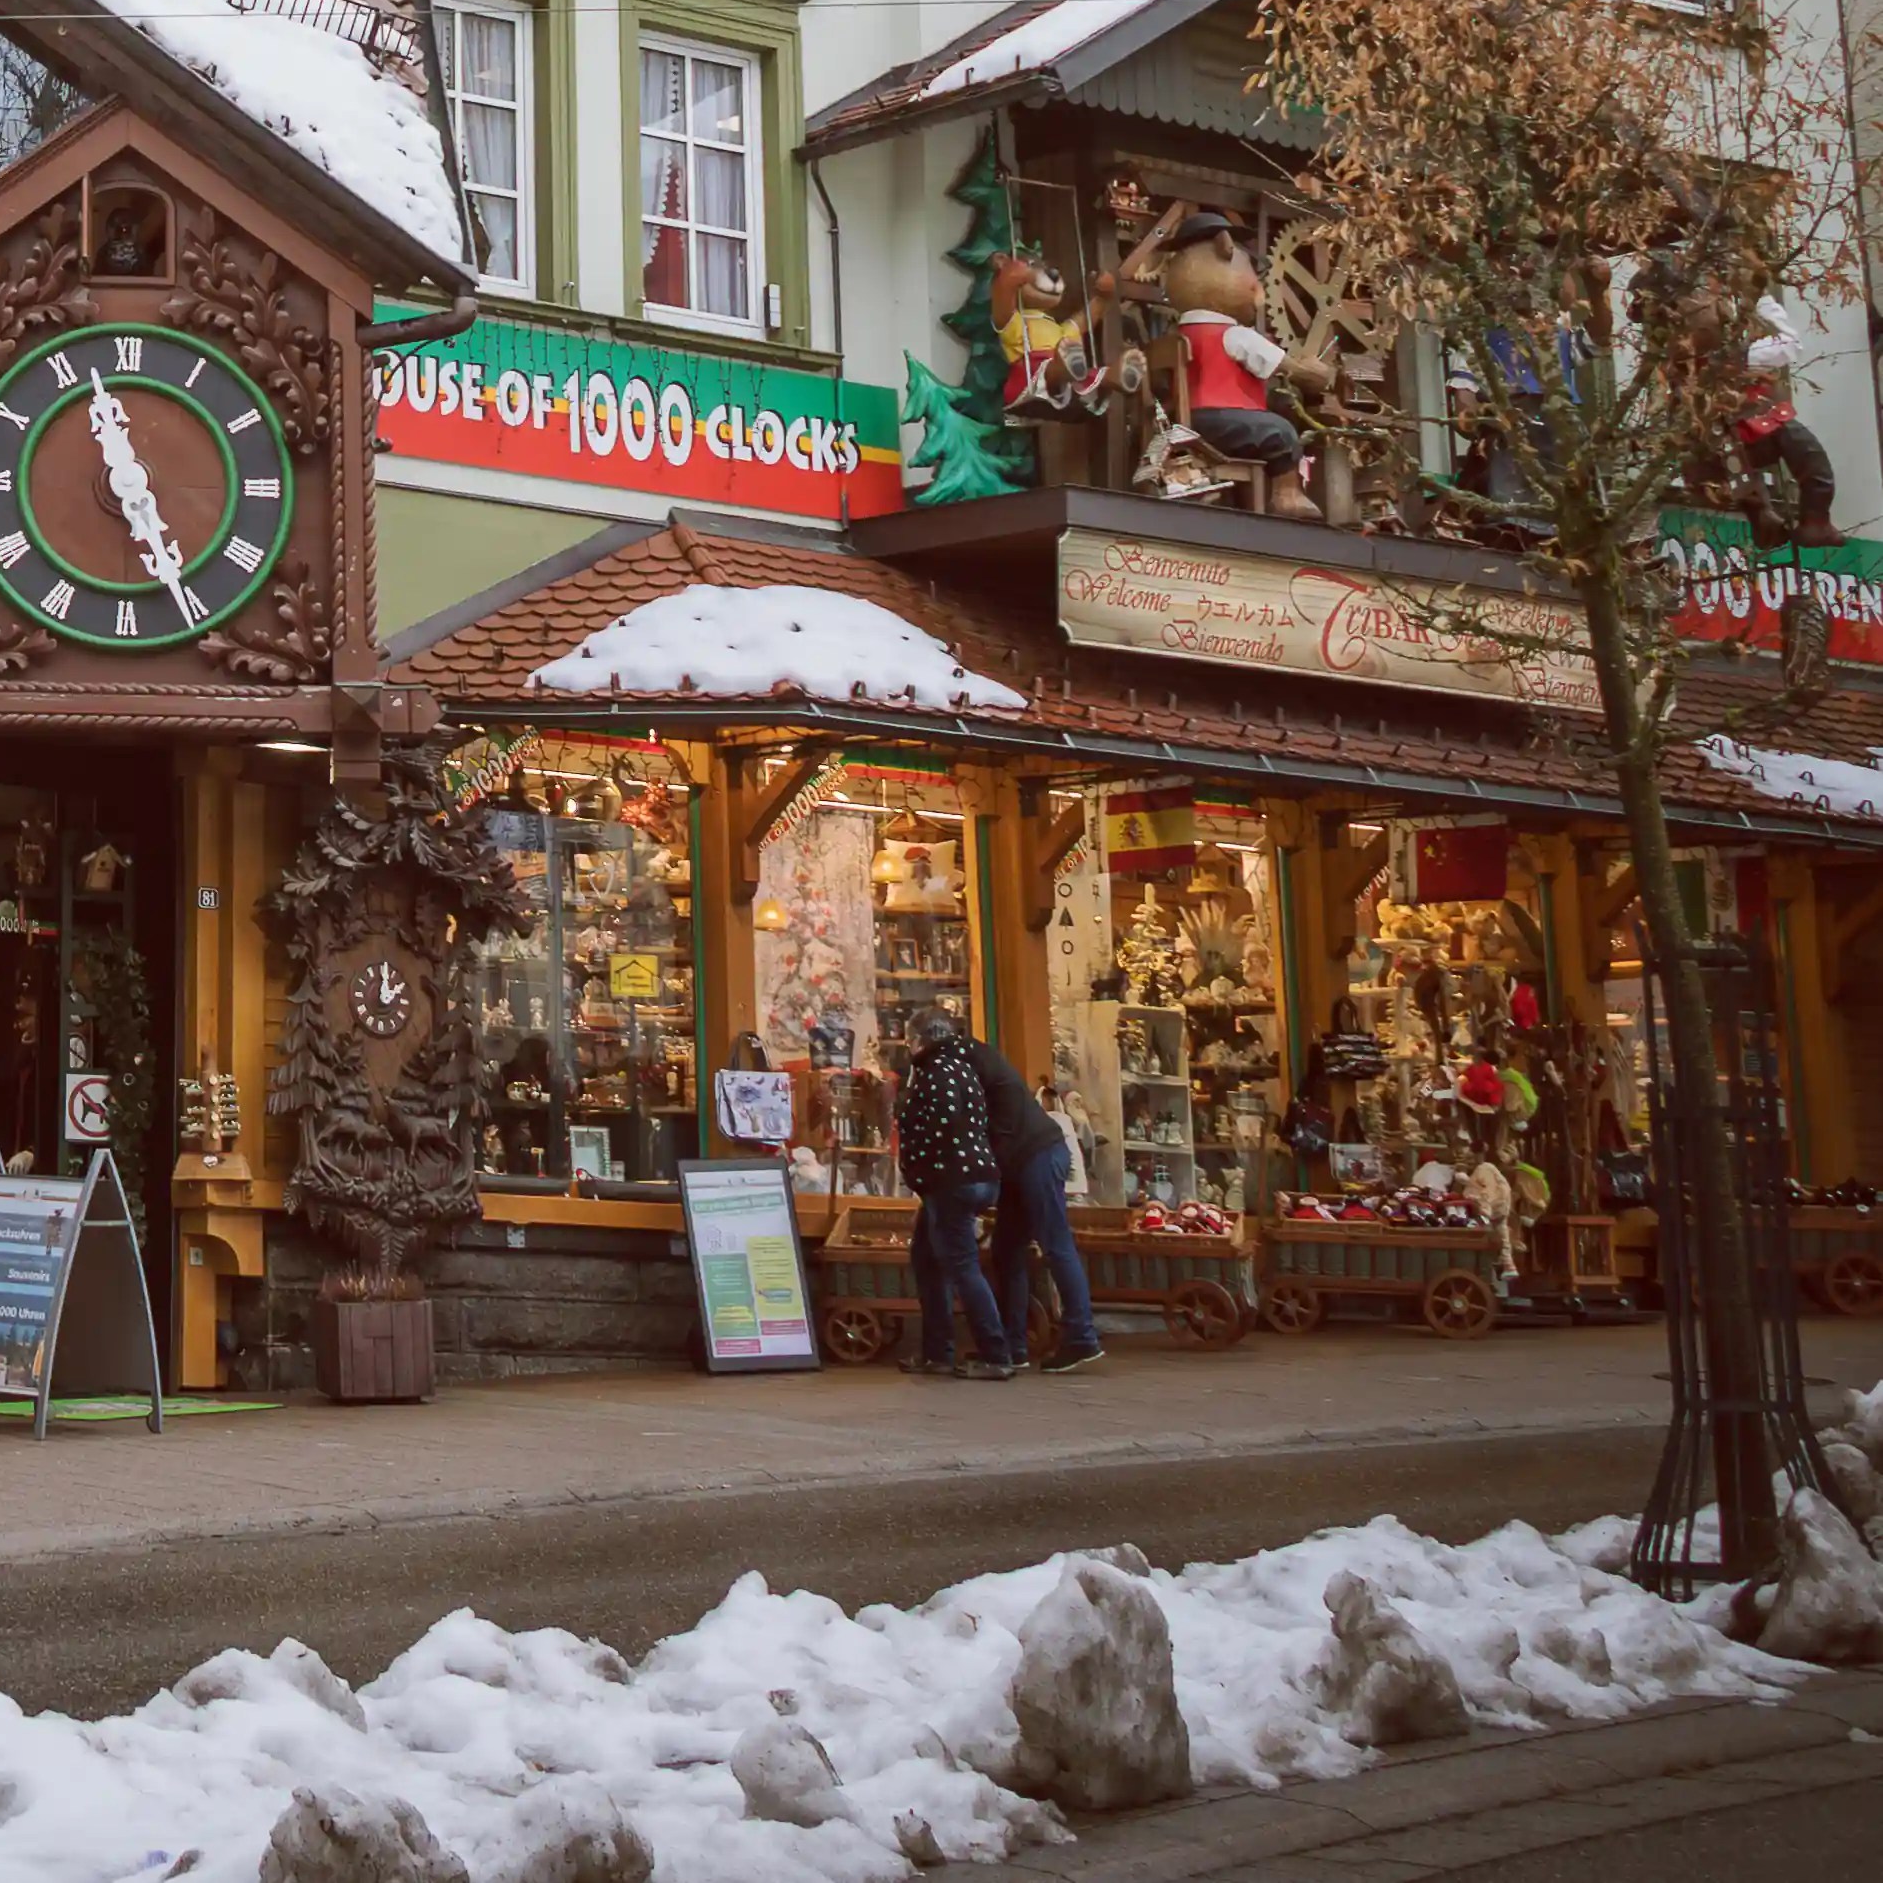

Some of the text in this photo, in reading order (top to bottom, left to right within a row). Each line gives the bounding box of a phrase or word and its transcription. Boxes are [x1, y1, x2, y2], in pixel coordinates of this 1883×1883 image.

[114, 336, 143, 372] XII
[373, 349, 860, 474] OUSE OF 1000 CLOCKS
[1104, 538, 1230, 586] Benvenuto
[1661, 538, 1750, 618] 000
[1064, 569, 1172, 613] Welcome
[1161, 618, 1285, 663] Bienvenido
[18, 1306, 46, 1321] Uhren
